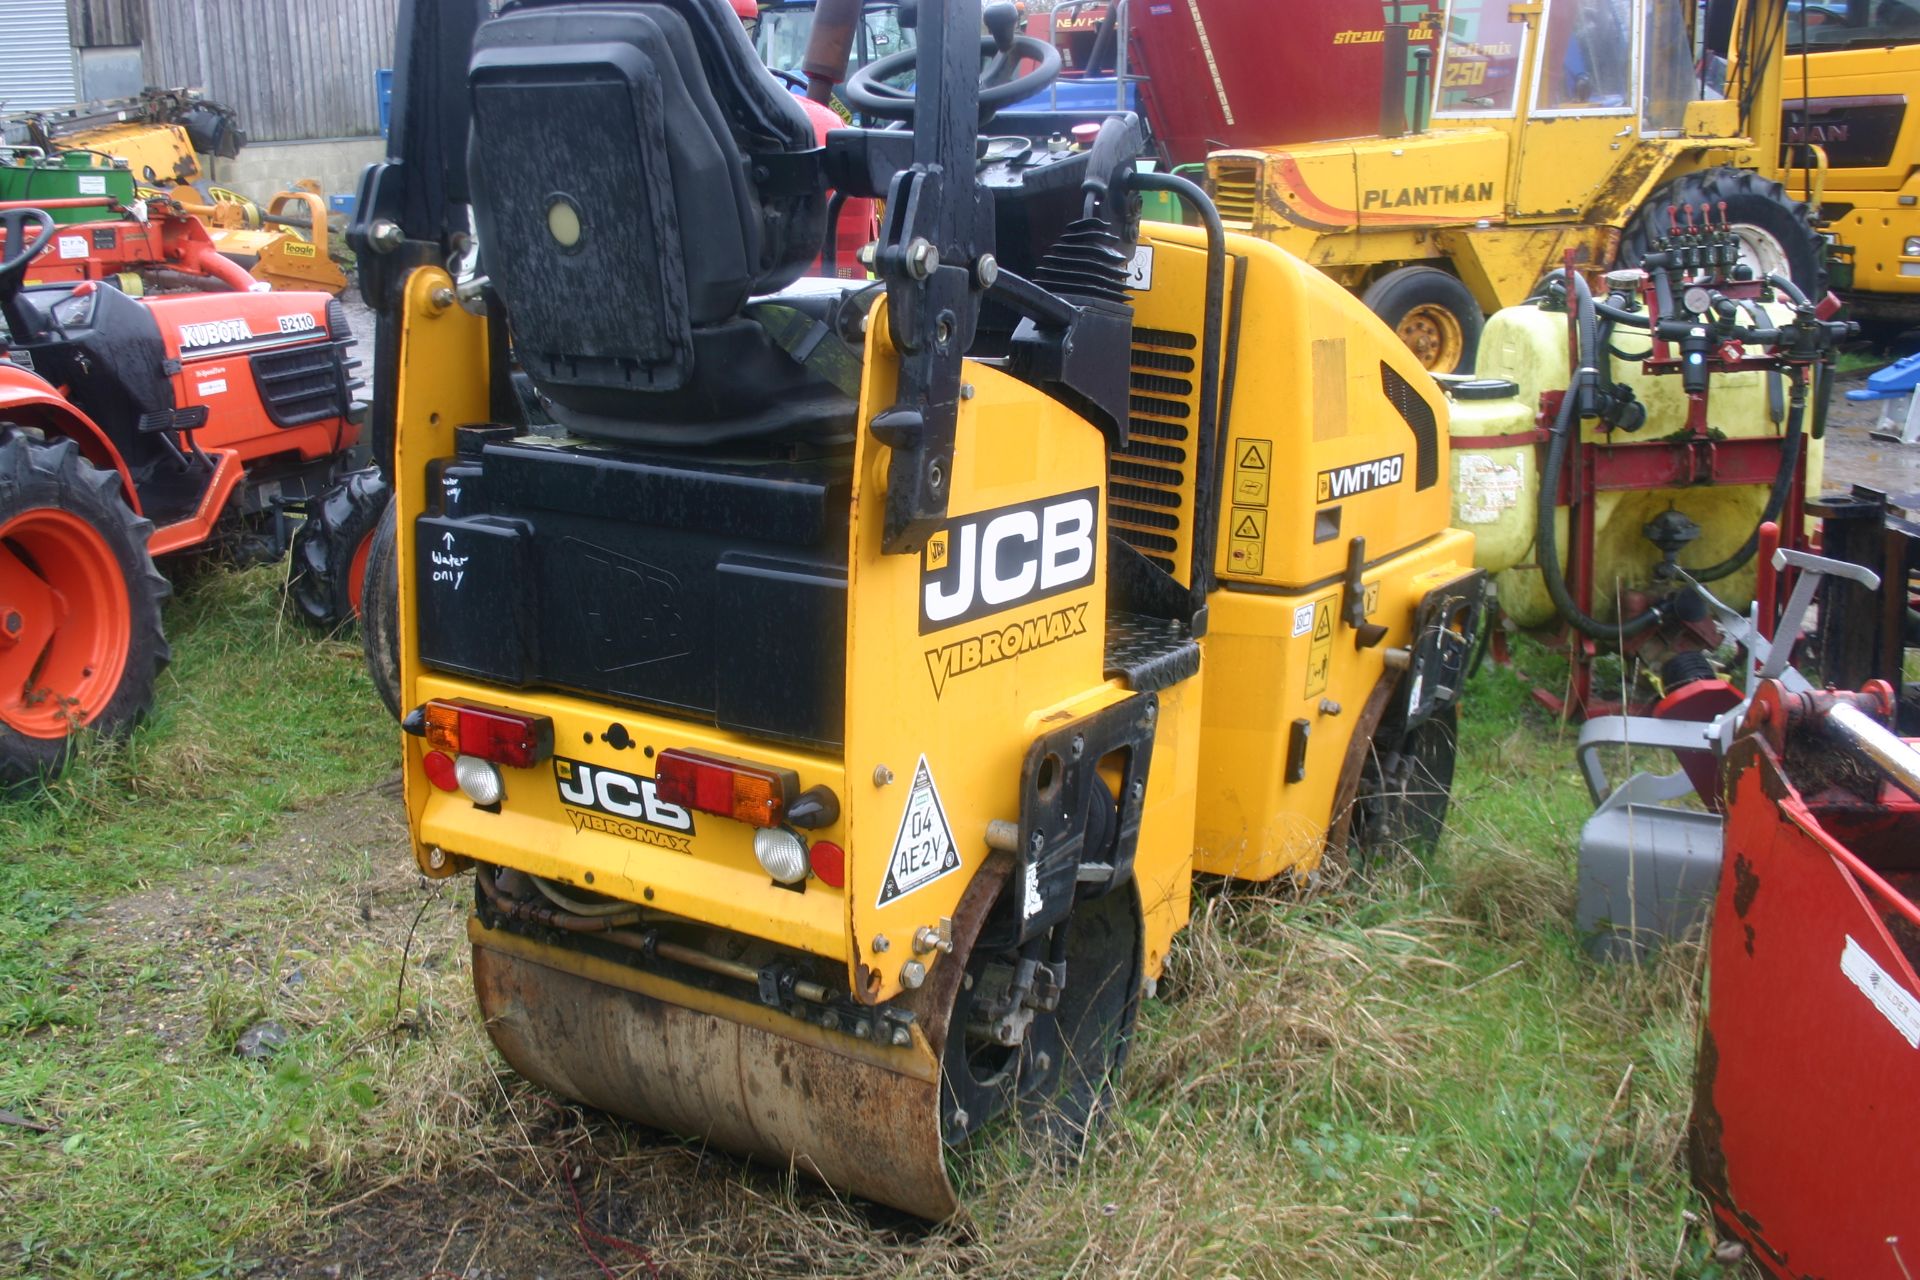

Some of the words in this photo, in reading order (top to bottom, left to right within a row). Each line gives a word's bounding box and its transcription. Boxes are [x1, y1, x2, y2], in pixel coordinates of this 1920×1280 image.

[1788, 125, 1848, 142] MAN
[1363, 182, 1493, 209] PLANTMAN
[286, 243, 314, 256] Teagle
[180, 319, 253, 347] KUBOTA
[280, 315, 315, 332] B2110
[1330, 456, 1402, 497] VMT160
[432, 551, 468, 567] Water
[925, 499, 1093, 621] JCB
[433, 571, 464, 590] only
[924, 602, 1088, 702] VIBROMAX
[560, 766, 690, 830] JCB
[565, 809, 693, 855] VIBROMAX
